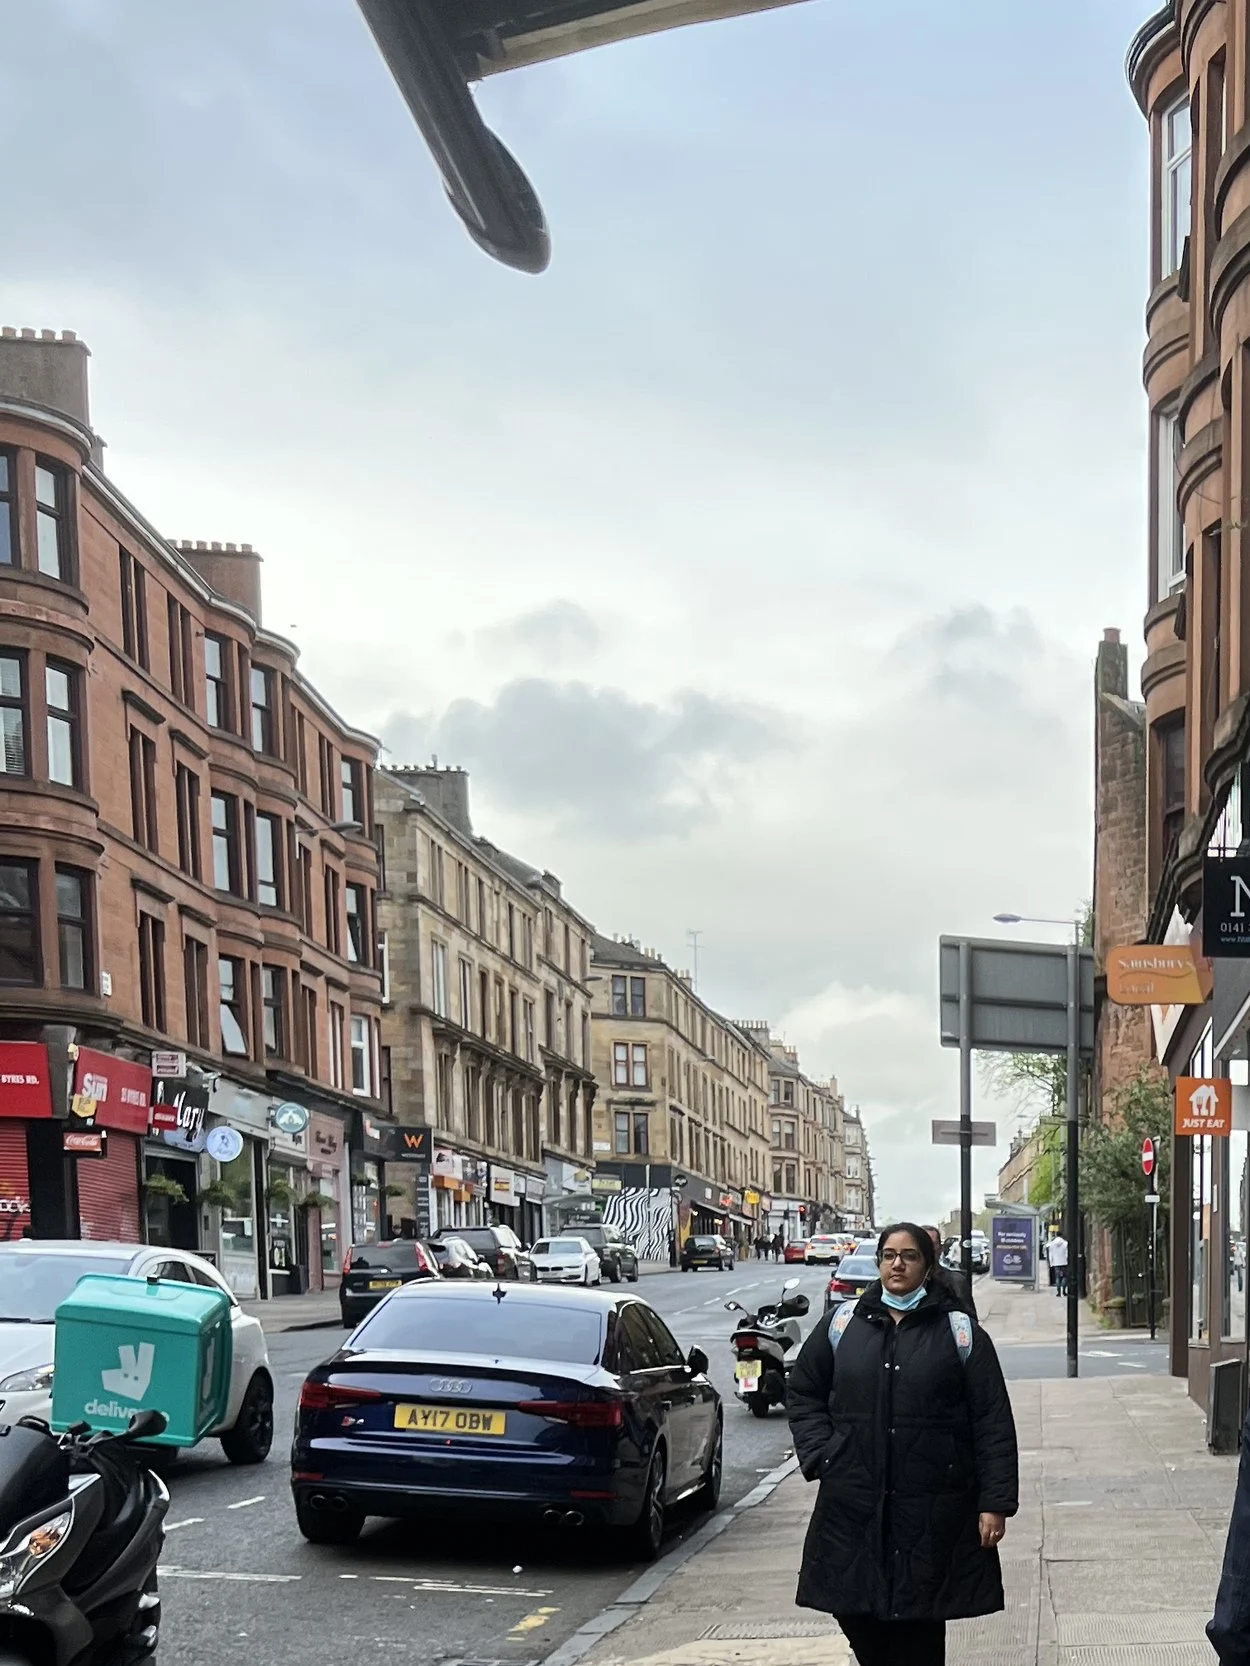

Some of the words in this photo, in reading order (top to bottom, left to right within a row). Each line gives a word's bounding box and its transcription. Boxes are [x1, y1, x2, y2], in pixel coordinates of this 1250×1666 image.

[1220, 922, 1244, 933] 0141
[1120, 982, 1154, 994] Local
[1182, 1118, 1206, 1129] JUST
[1206, 1119, 1225, 1128] EAT
[743, 1378, 753, 1388] L
[407, 1408, 451, 1428] AY17
[455, 1411, 494, 1431] OBW
